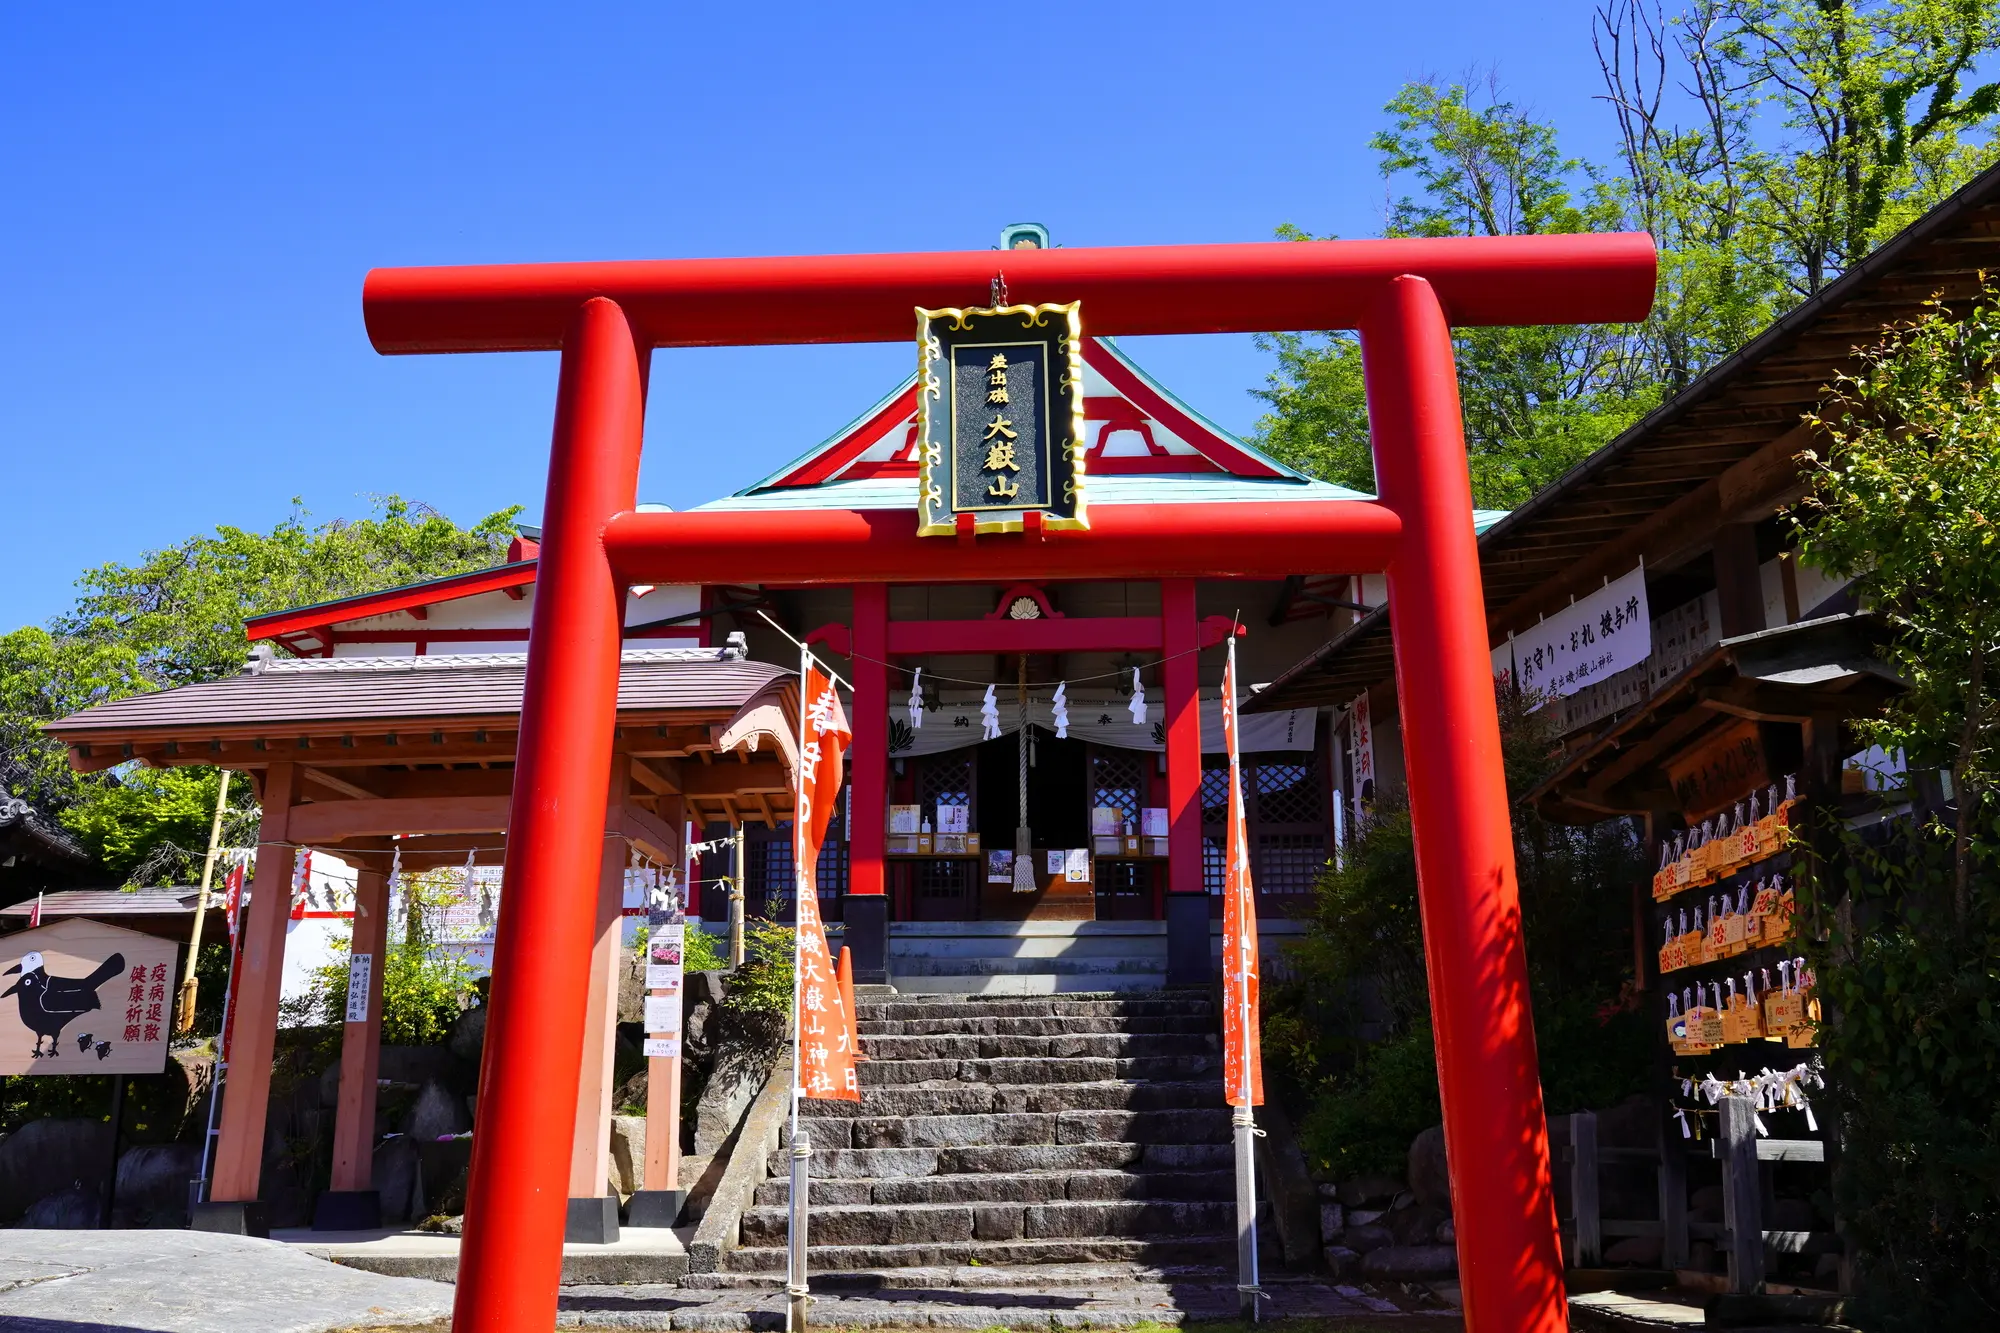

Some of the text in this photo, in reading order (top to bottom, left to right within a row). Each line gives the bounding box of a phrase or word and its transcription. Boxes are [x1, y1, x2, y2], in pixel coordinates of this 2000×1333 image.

[983, 352, 1021, 498] 差出磯 大嶽山
[1523, 623, 1596, 682] お守り・お札
[1599, 595, 1639, 639] 授与所
[953, 713, 1113, 728] 奉 納
[122, 964, 148, 1042] 健康祈願
[143, 962, 168, 1042] 疫病退散
